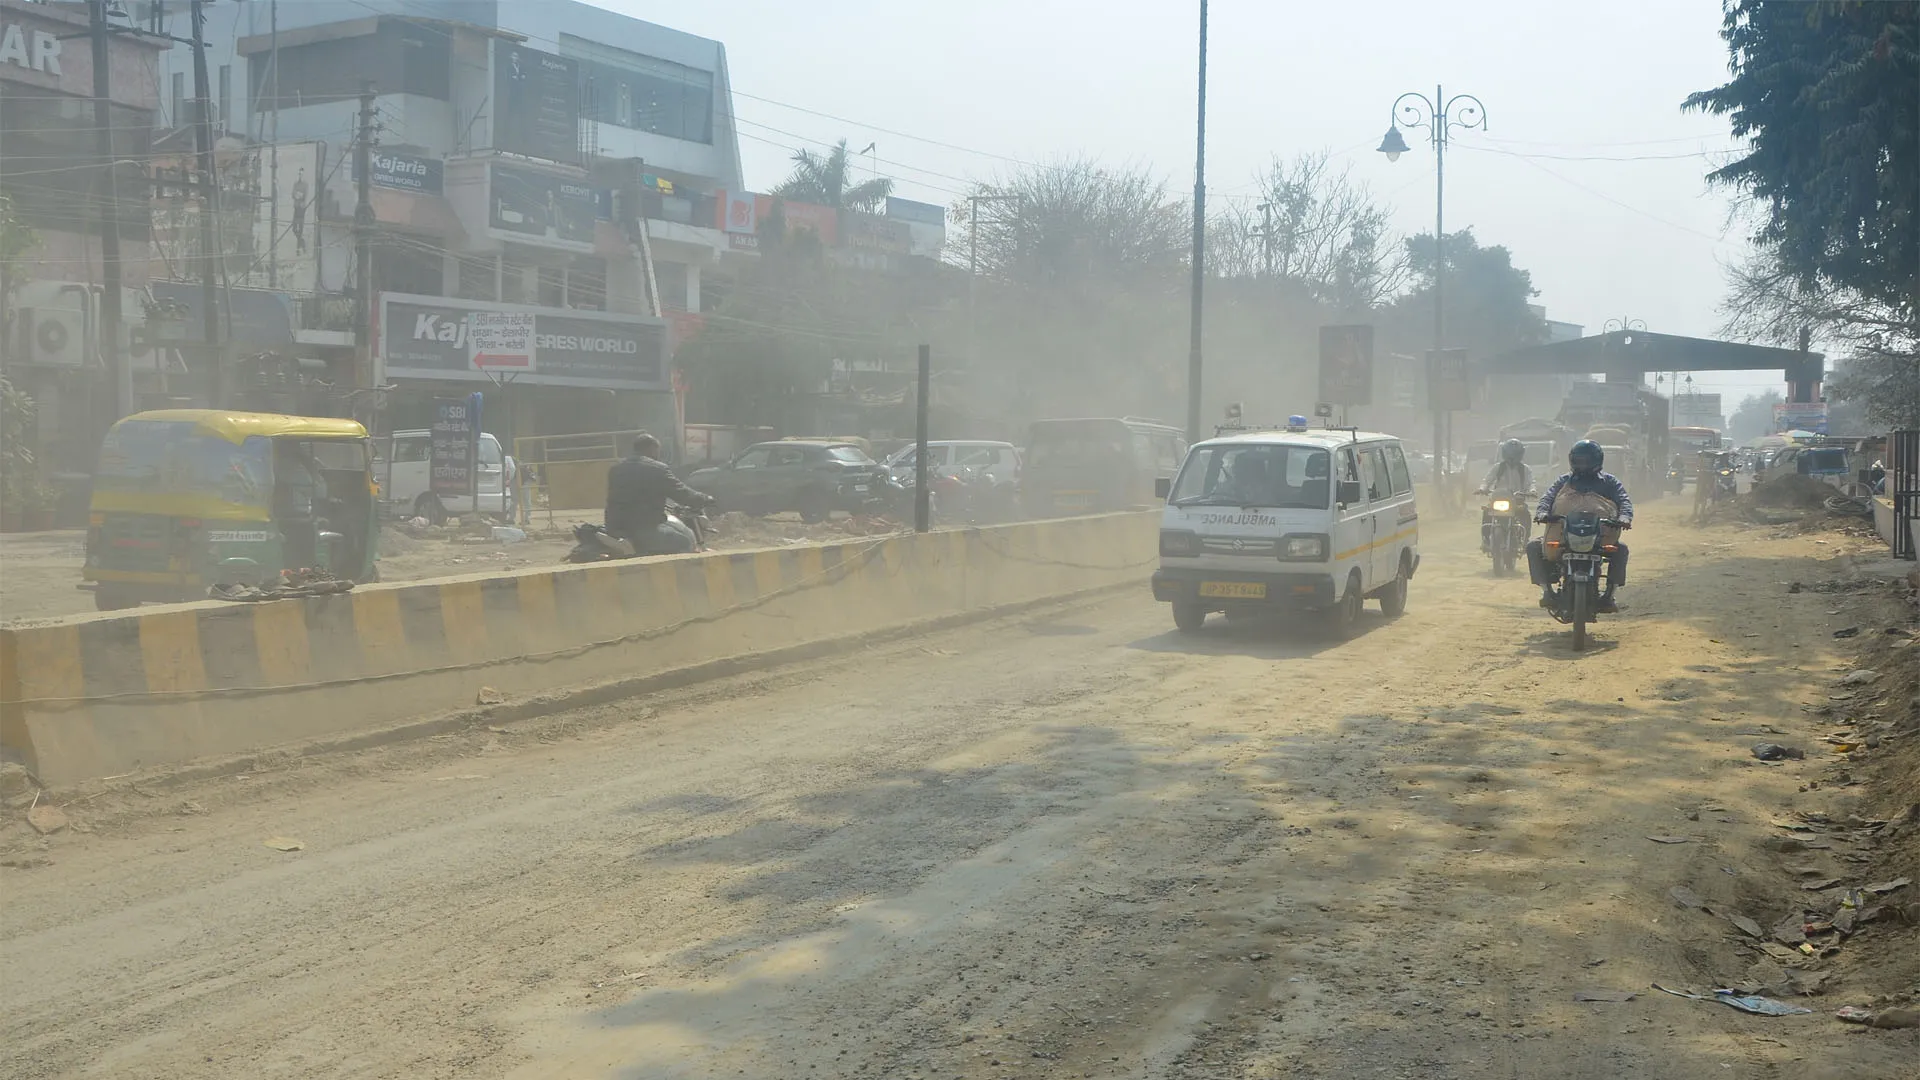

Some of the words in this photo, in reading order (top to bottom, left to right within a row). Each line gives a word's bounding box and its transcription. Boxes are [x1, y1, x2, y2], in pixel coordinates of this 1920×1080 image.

[0, 24, 63, 76] AR
[372, 153, 427, 176] Kajaria
[580, 336, 637, 354] WORLD
[448, 406, 467, 419] SBI
